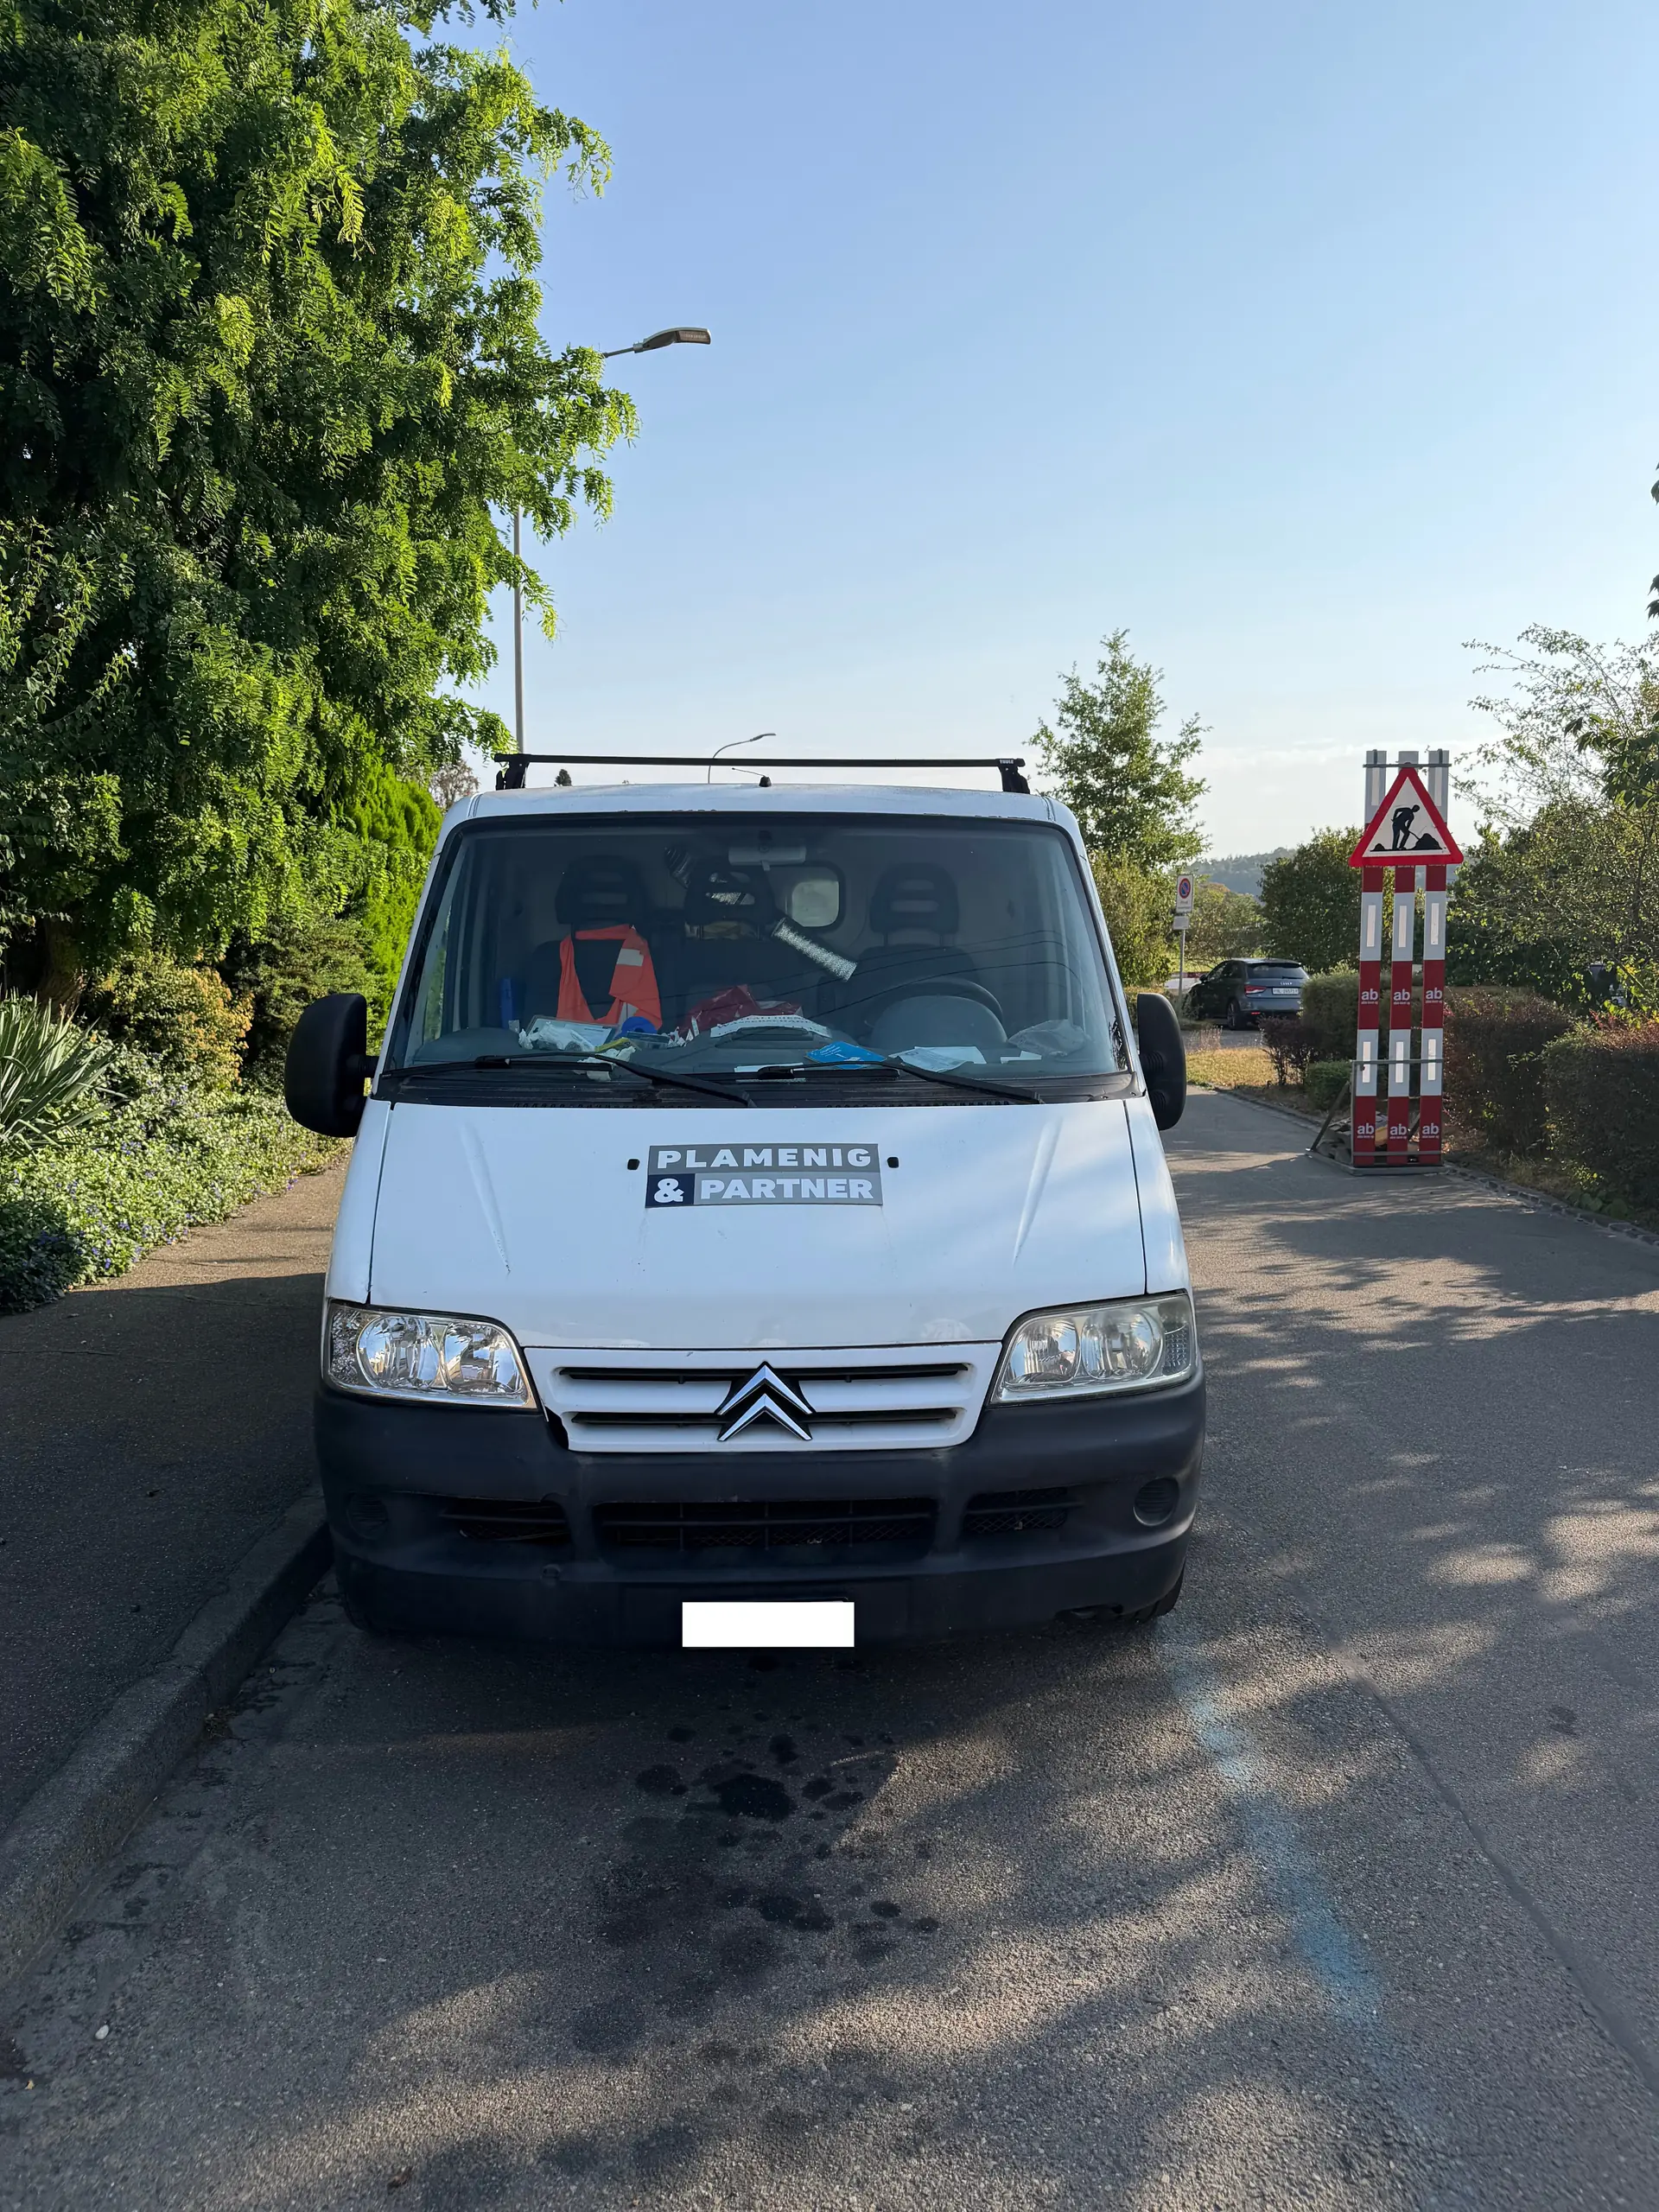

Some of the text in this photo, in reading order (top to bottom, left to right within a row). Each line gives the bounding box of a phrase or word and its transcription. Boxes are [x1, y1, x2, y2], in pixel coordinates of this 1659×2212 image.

[1361, 988, 1379, 1001] ab
[1393, 988, 1411, 1001] ab
[1425, 987, 1443, 1000] ab
[1357, 1122, 1375, 1135] ab
[1389, 1123, 1408, 1135] ab
[1421, 1122, 1440, 1135] ab
[657, 1147, 871, 1169] PLAMENIG
[653, 1178, 874, 1204] & PARTNER
